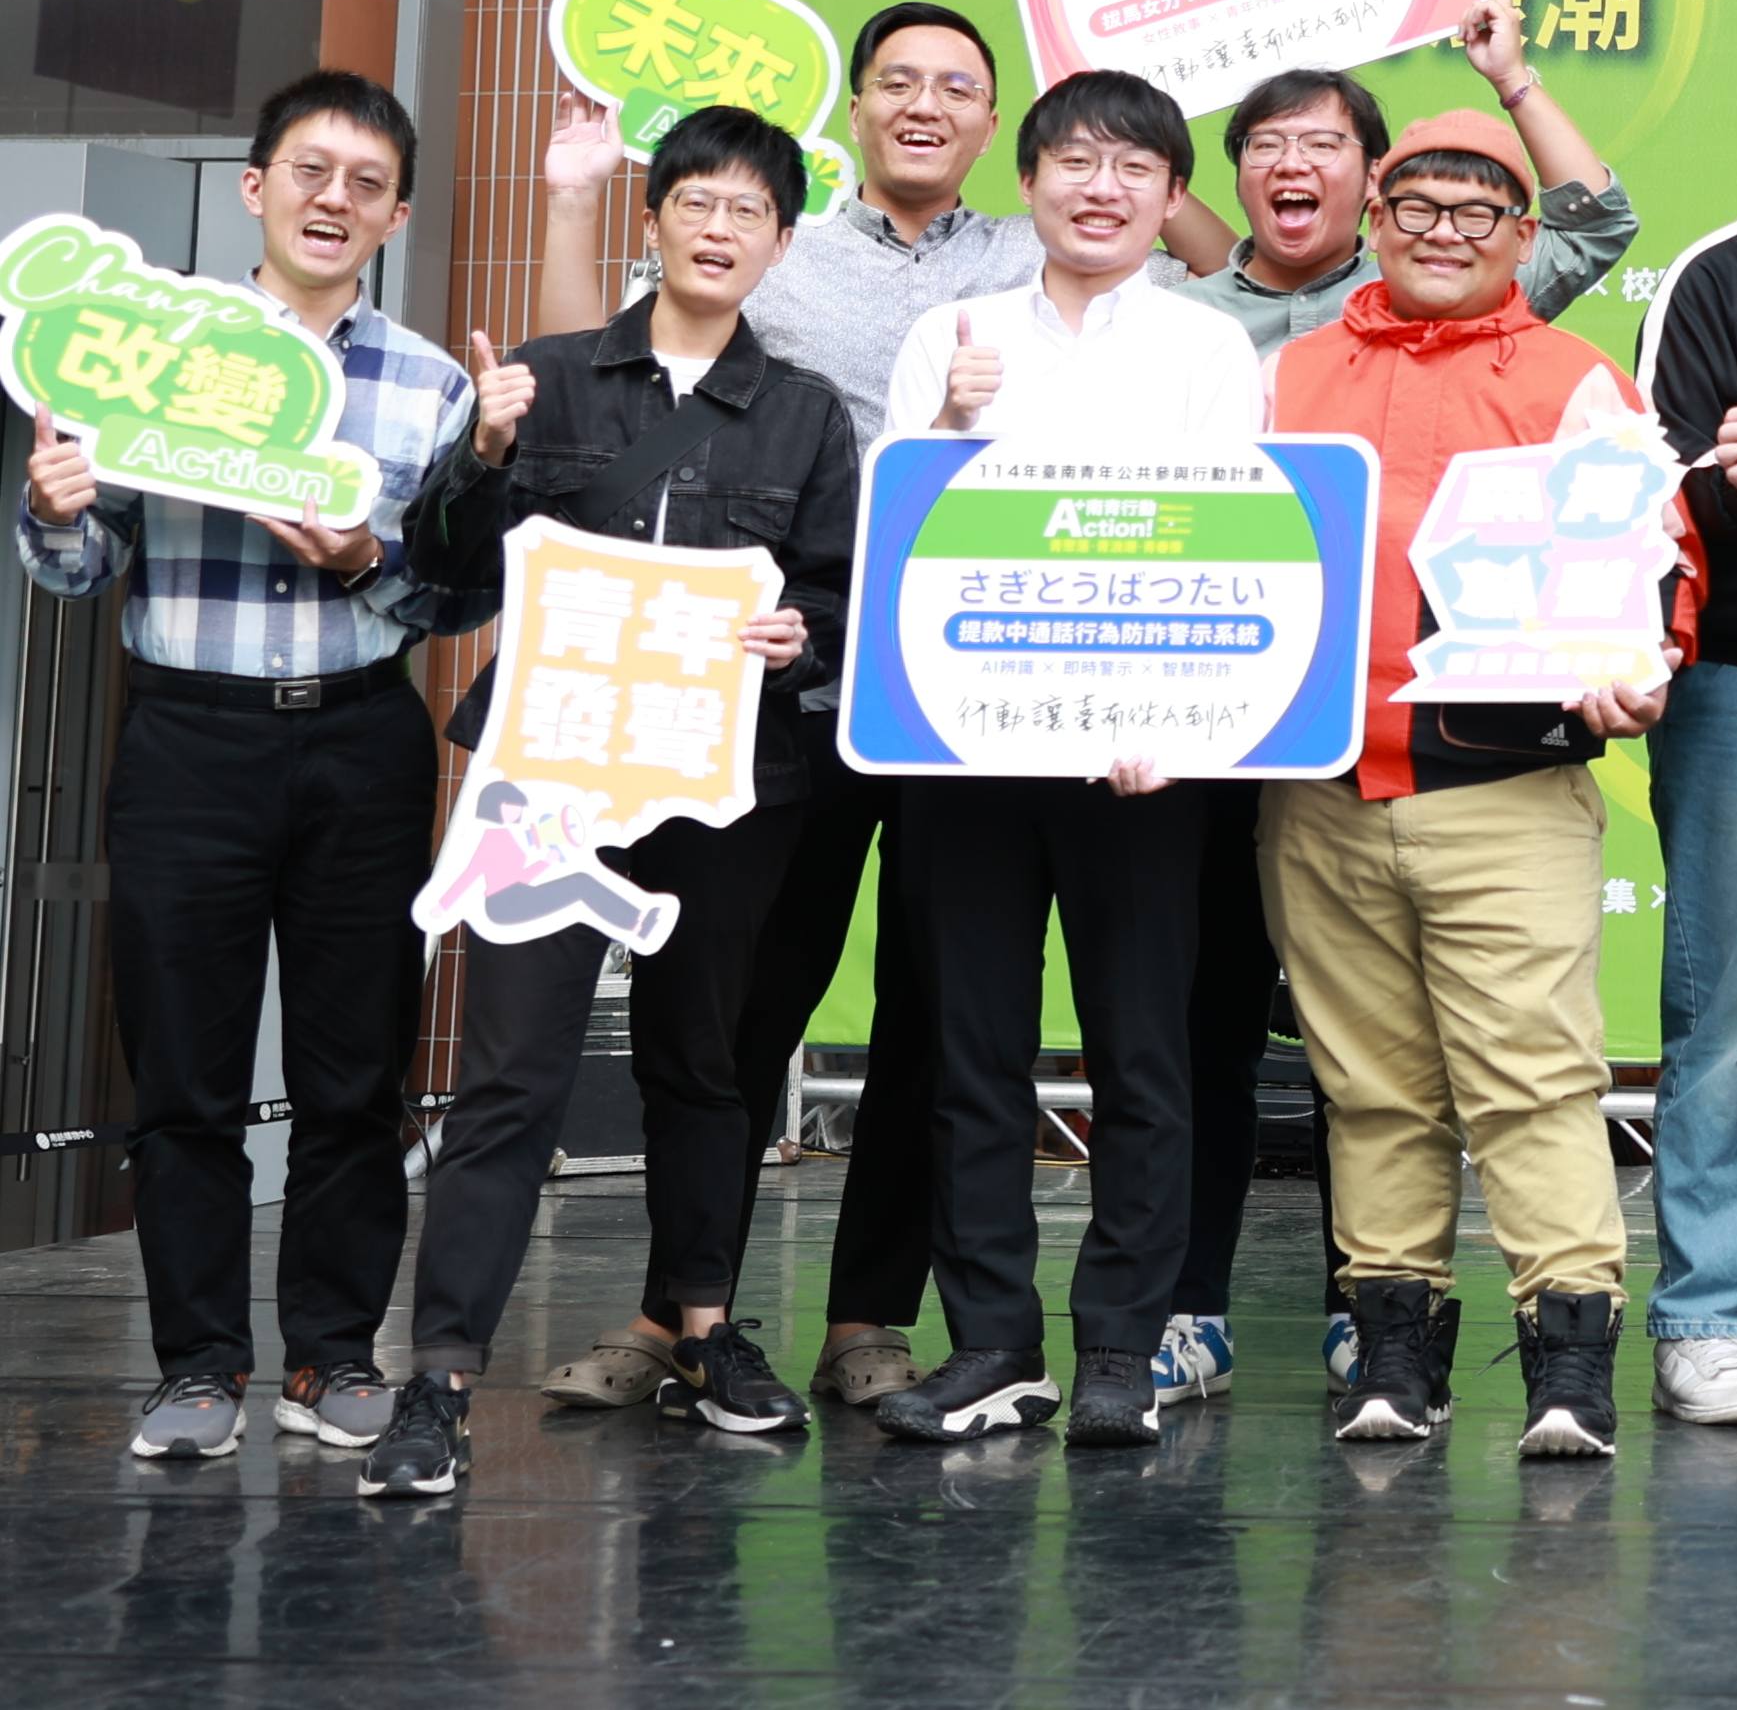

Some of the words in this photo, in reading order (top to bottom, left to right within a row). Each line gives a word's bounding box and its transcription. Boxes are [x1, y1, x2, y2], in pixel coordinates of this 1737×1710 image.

[27, 238, 256, 328] Change
[57, 309, 290, 448] 改變
[121, 427, 334, 506] Action
[978, 462, 1266, 484] 114年臺南青年公共參與行動計畫
[959, 570, 1266, 608] さぎとうばつたい
[538, 569, 741, 677] 青年
[957, 619, 1260, 647] 提款中通話行為防詐警示系統
[1062, 659, 1134, 677] 即時警示
[1161, 660, 1233, 678] 智慧防詐
[518, 664, 725, 780] 發聲
[1602, 877, 1637, 914] 集
